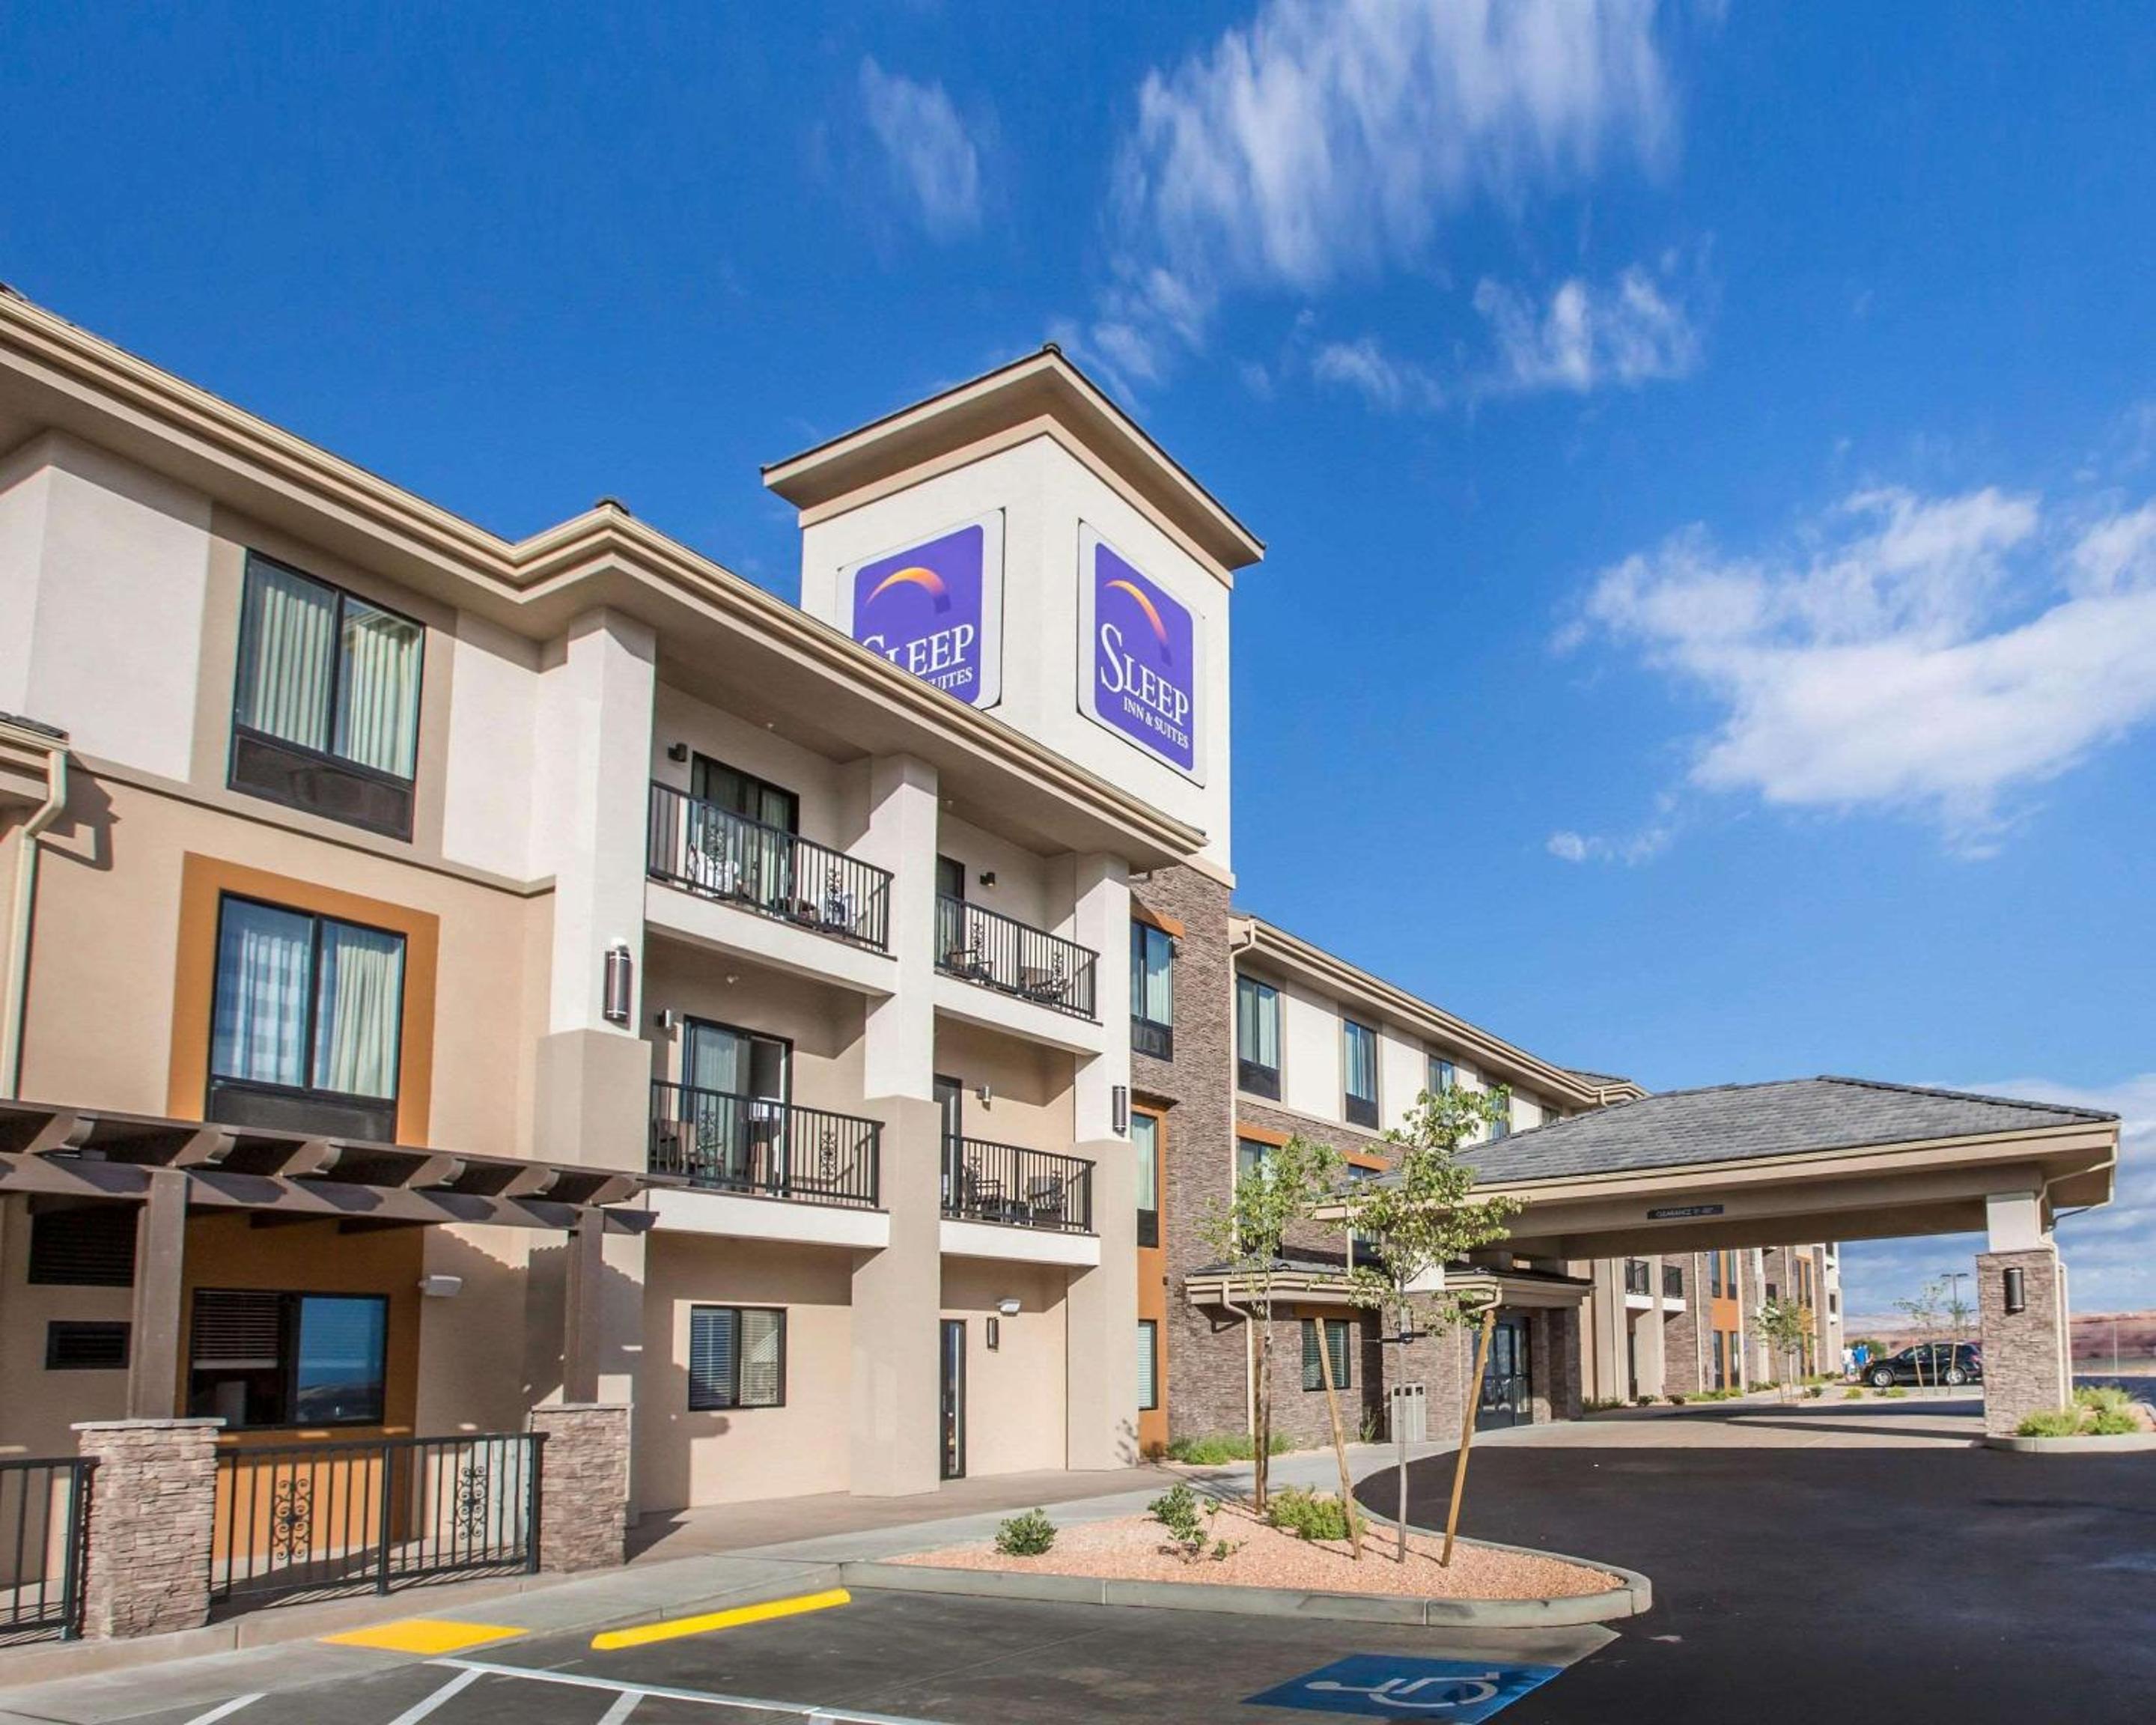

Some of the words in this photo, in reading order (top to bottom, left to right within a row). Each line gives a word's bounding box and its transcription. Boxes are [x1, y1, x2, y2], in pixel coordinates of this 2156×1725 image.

[862, 624, 974, 676] EEP
[1100, 623, 1189, 725] SLEEP
[1124, 696, 1144, 721] INN
[1145, 712, 1153, 726] &
[1154, 717, 1189, 749] SUITES
